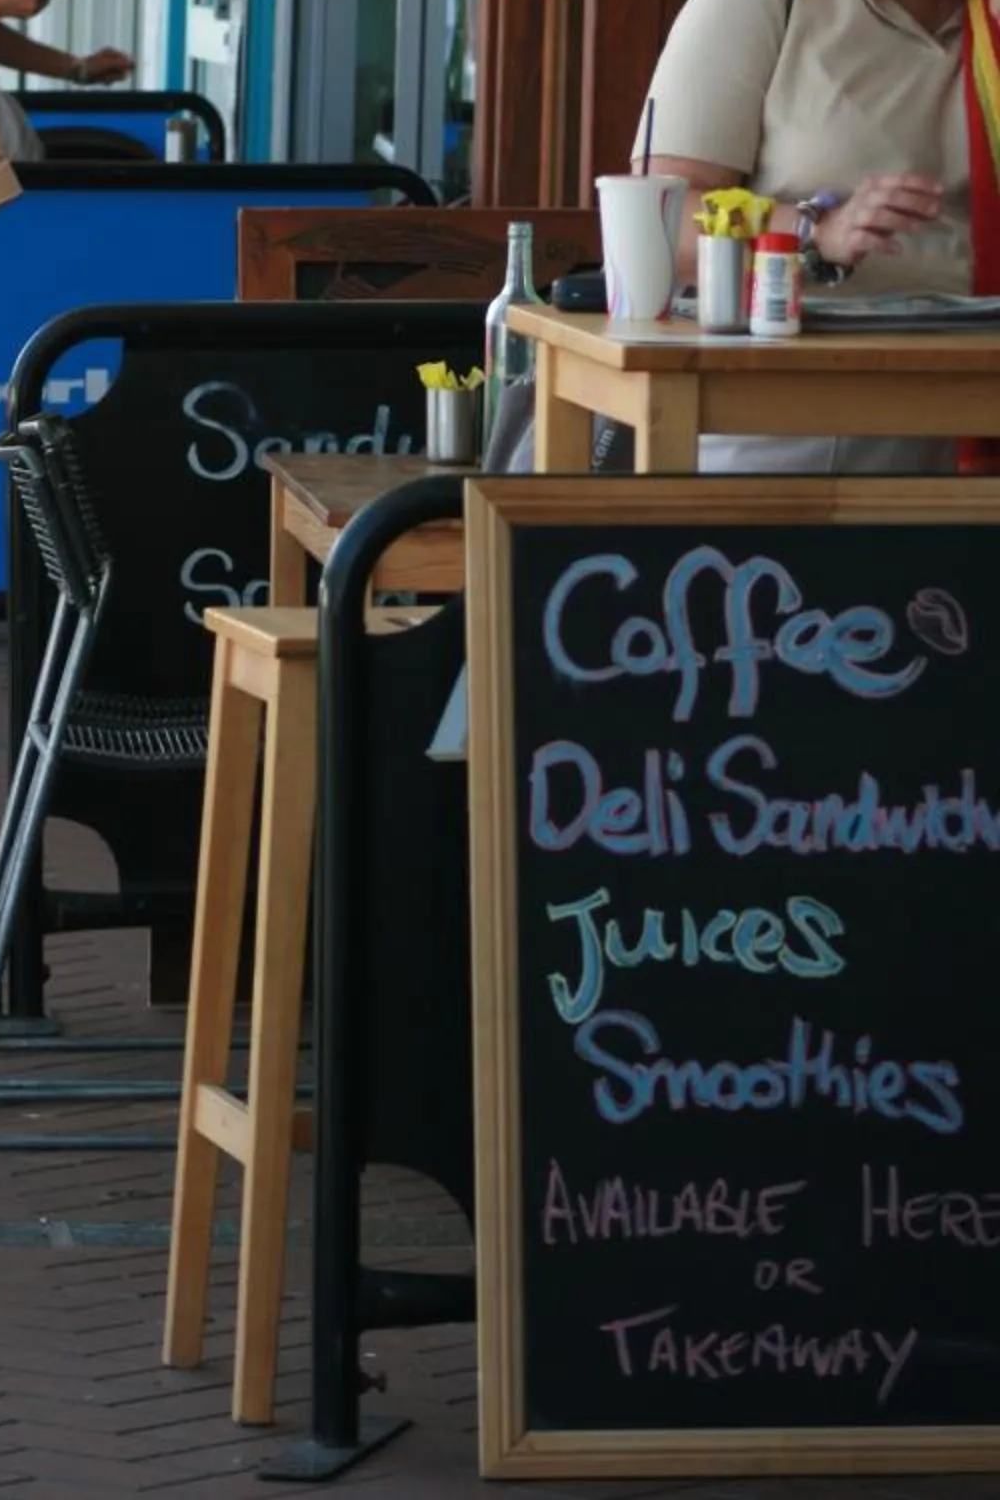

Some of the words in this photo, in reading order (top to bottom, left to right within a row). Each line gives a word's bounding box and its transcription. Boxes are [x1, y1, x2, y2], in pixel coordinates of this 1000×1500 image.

[543, 546, 927, 722] Coffee
[529, 739, 691, 858] Deli
[546, 888, 846, 1024] Juices
[574, 1009, 965, 1134] Smoothies
[540, 1156, 808, 1246] AVAILABLE
[753, 1257, 825, 1295] OR
[599, 1303, 920, 1403] TAKEAWAY
